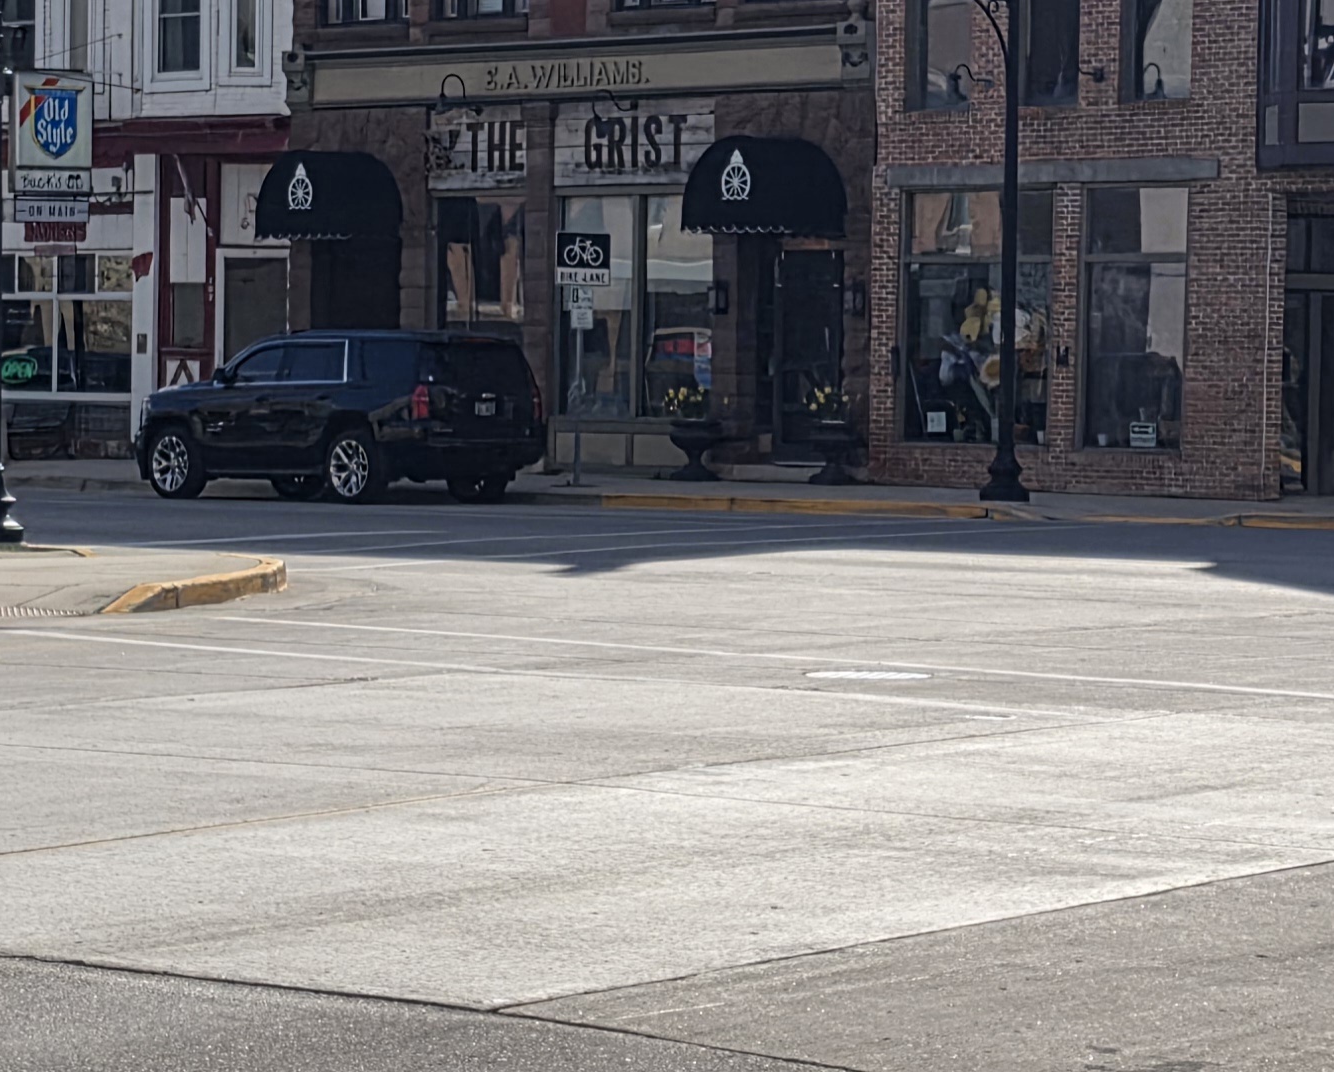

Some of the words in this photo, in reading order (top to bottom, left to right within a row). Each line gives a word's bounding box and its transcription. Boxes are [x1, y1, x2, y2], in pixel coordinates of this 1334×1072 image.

[43, 97, 69, 121] Old
[37, 118, 74, 153] Style
[466, 121, 525, 173] THE
[584, 114, 688, 171] GRIST
[28, 205, 43, 217] ON
[48, 205, 76, 218] MAIN
[1, 361, 34, 378] OPEN
